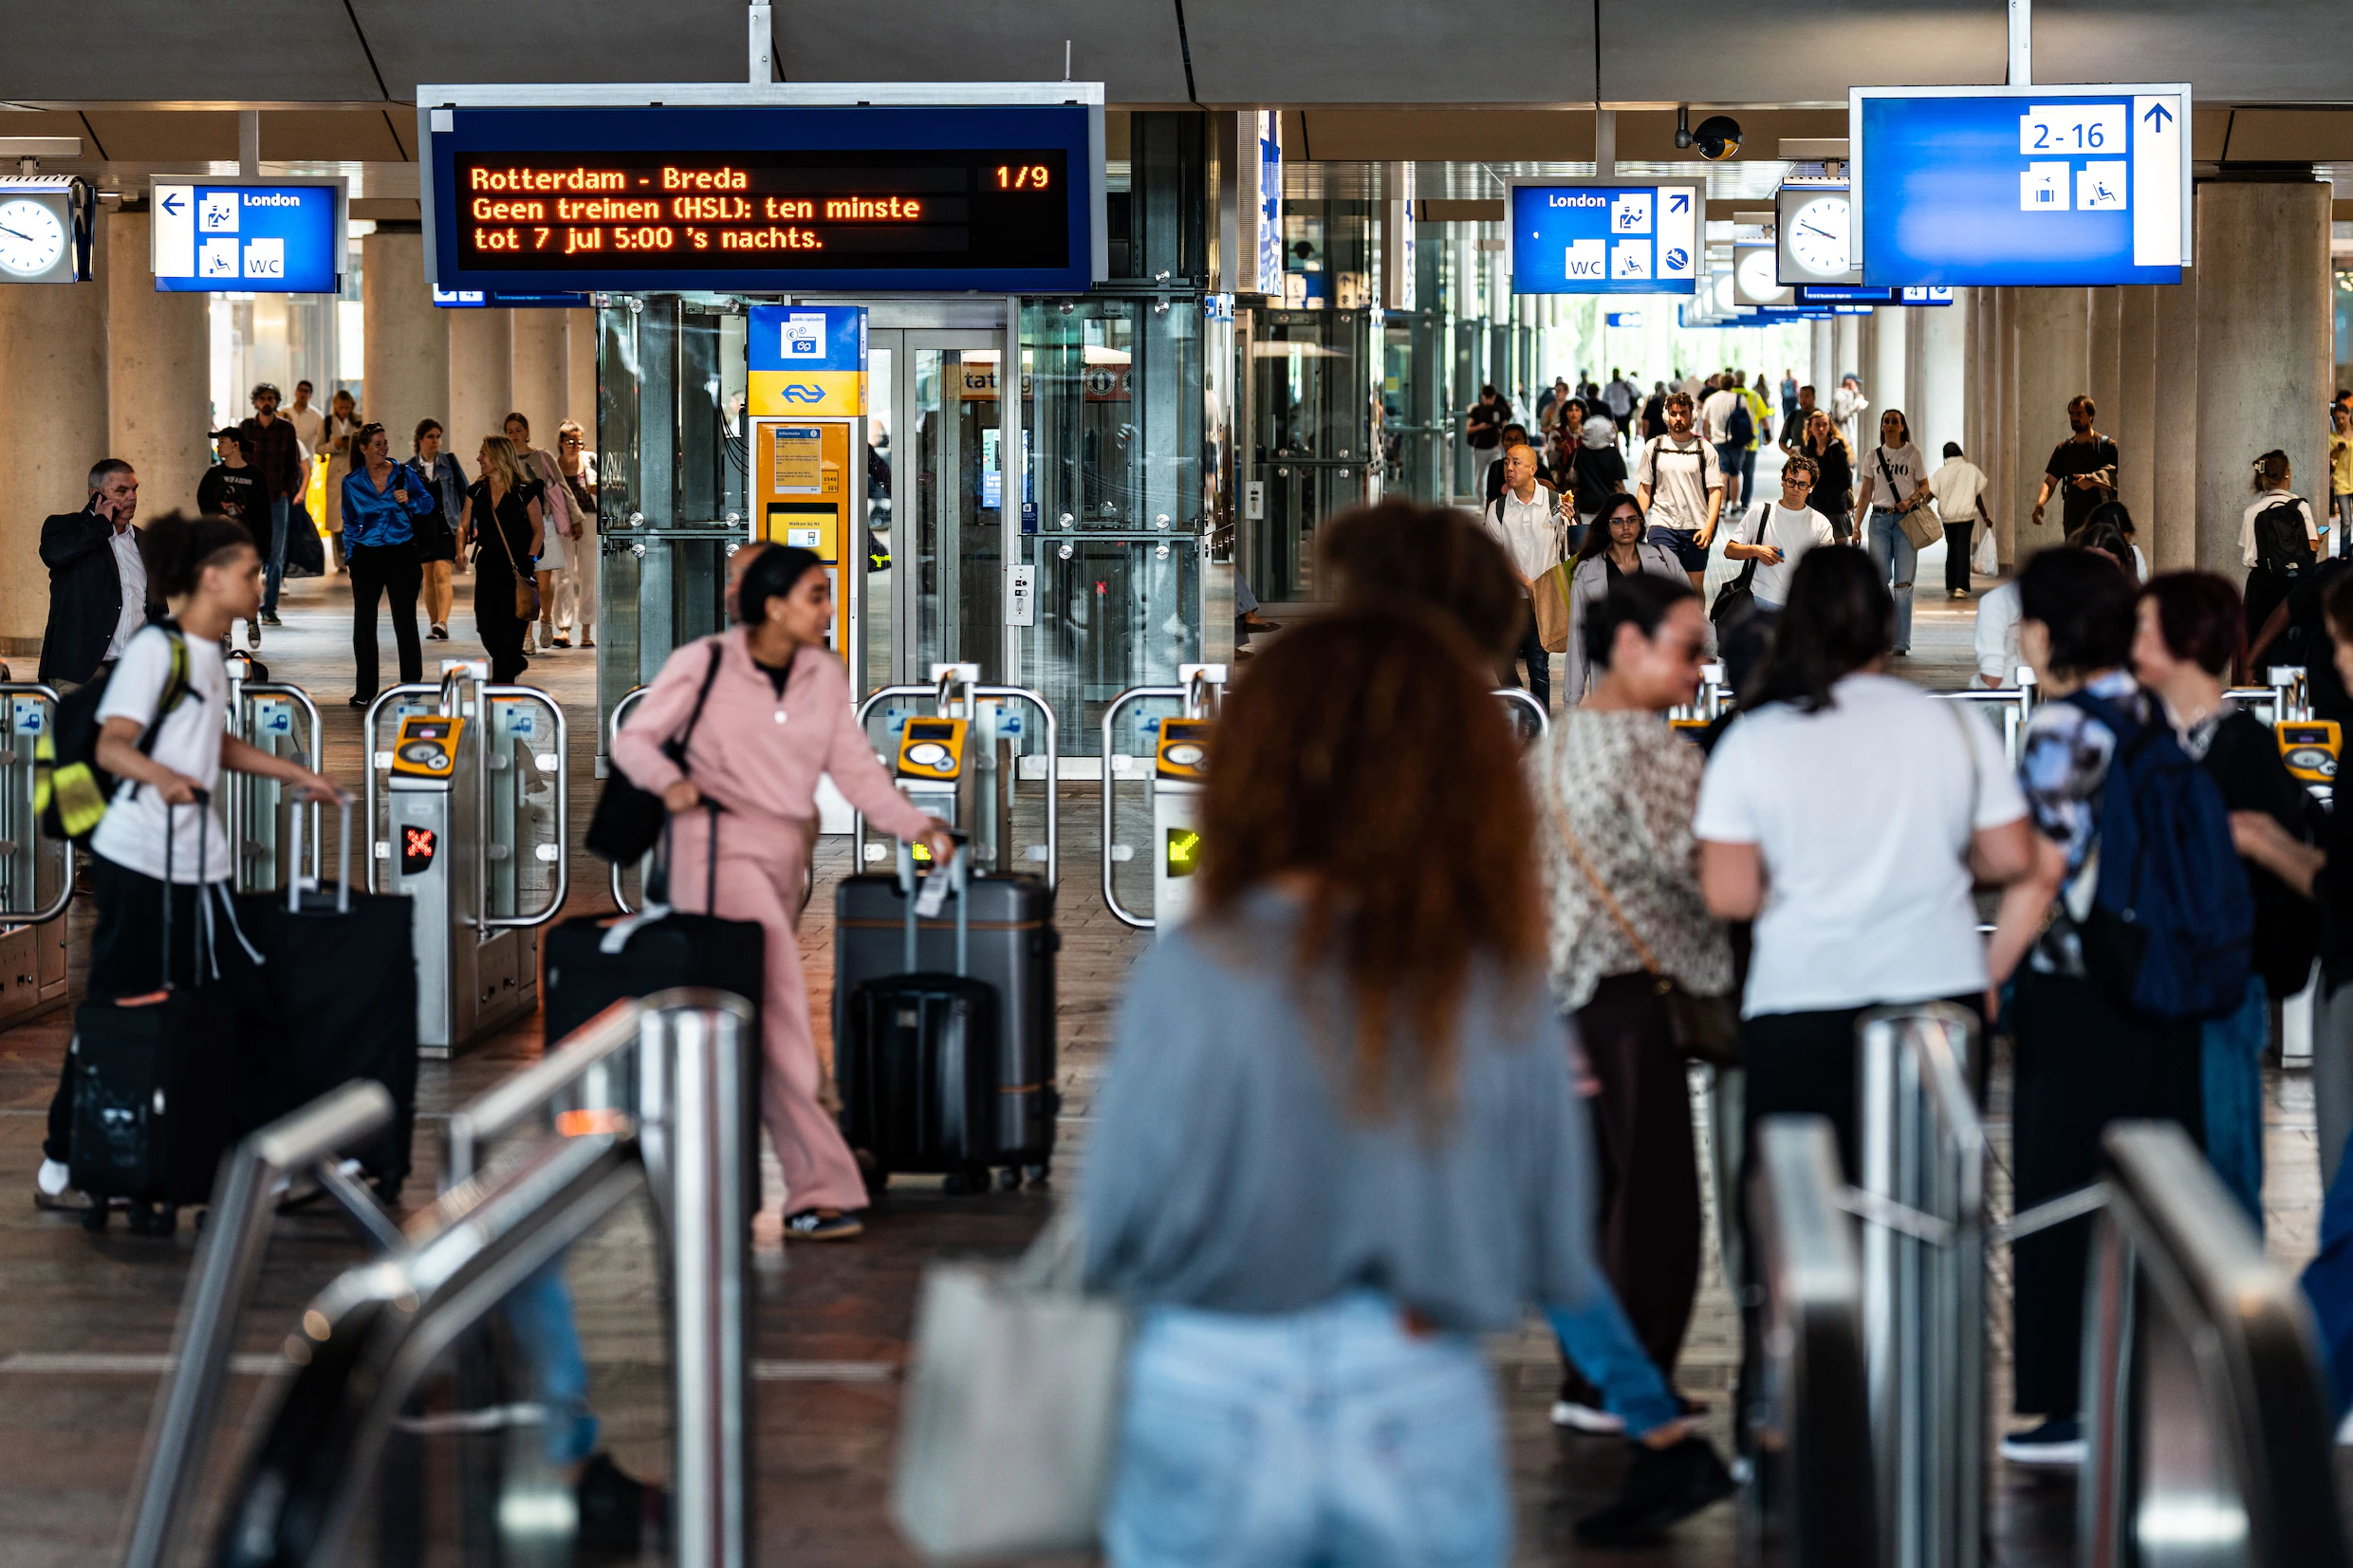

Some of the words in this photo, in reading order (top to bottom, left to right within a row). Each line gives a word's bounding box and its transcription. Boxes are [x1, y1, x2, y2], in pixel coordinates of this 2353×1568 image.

[2033, 123, 2050, 149] 2
[2071, 122, 2104, 149] 16
[471, 167, 625, 191] Rotterdam
[663, 167, 747, 190] Breda
[997, 166, 1048, 188] 1/9
[243, 193, 301, 207] London
[472, 197, 544, 220] Geen
[557, 197, 660, 220] treinen
[673, 196, 751, 220] (HSL):
[765, 196, 813, 219] ten
[826, 196, 920, 219] minste
[1549, 194, 1606, 208] London
[474, 228, 520, 249] tot
[533, 227, 550, 249] 7
[564, 227, 602, 254] jul
[614, 227, 673, 249] 5:00
[721, 227, 823, 249] nachts.
[250, 260, 280, 273] WC
[1570, 261, 1602, 275] WC
